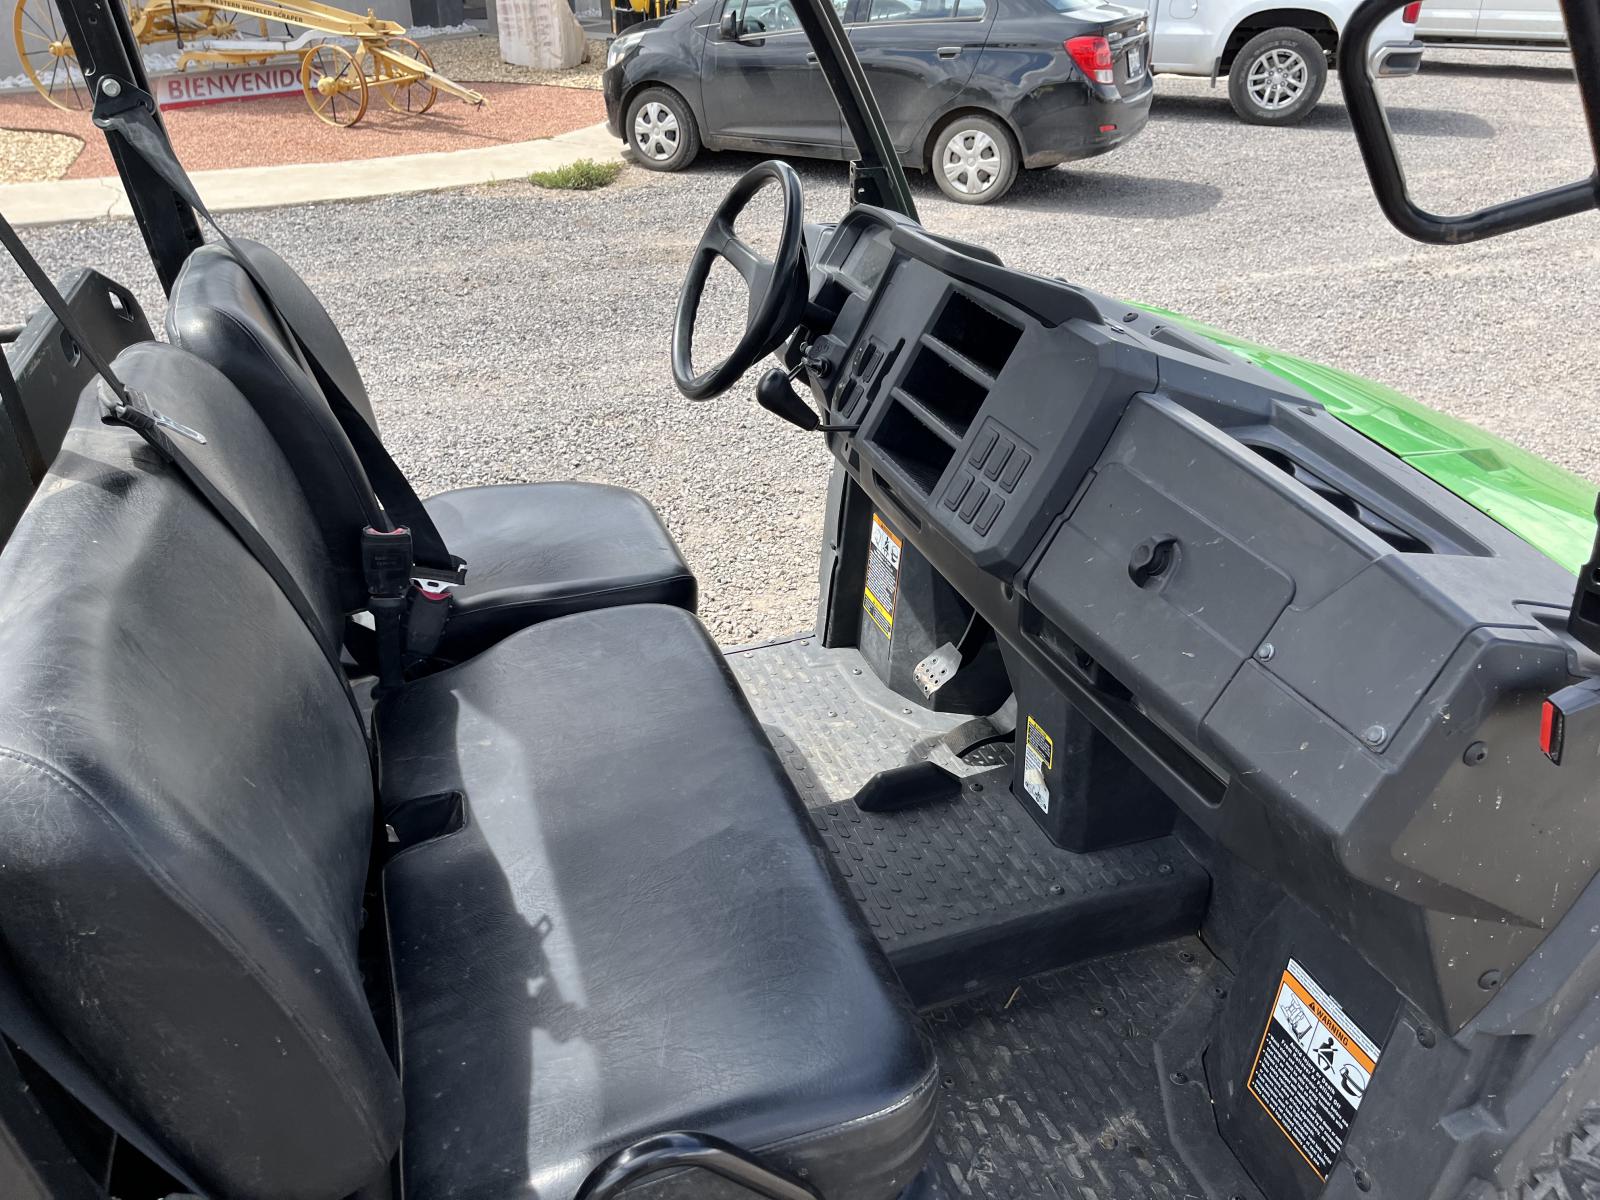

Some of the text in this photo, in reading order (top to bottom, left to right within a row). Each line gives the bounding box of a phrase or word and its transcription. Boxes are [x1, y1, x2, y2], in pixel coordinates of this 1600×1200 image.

[242, 4, 272, 16] WHEELED
[273, 10, 302, 22] SCRAPER
[1316, 1008, 1348, 1046] WARNING
[1320, 1076, 1335, 1096] Death
